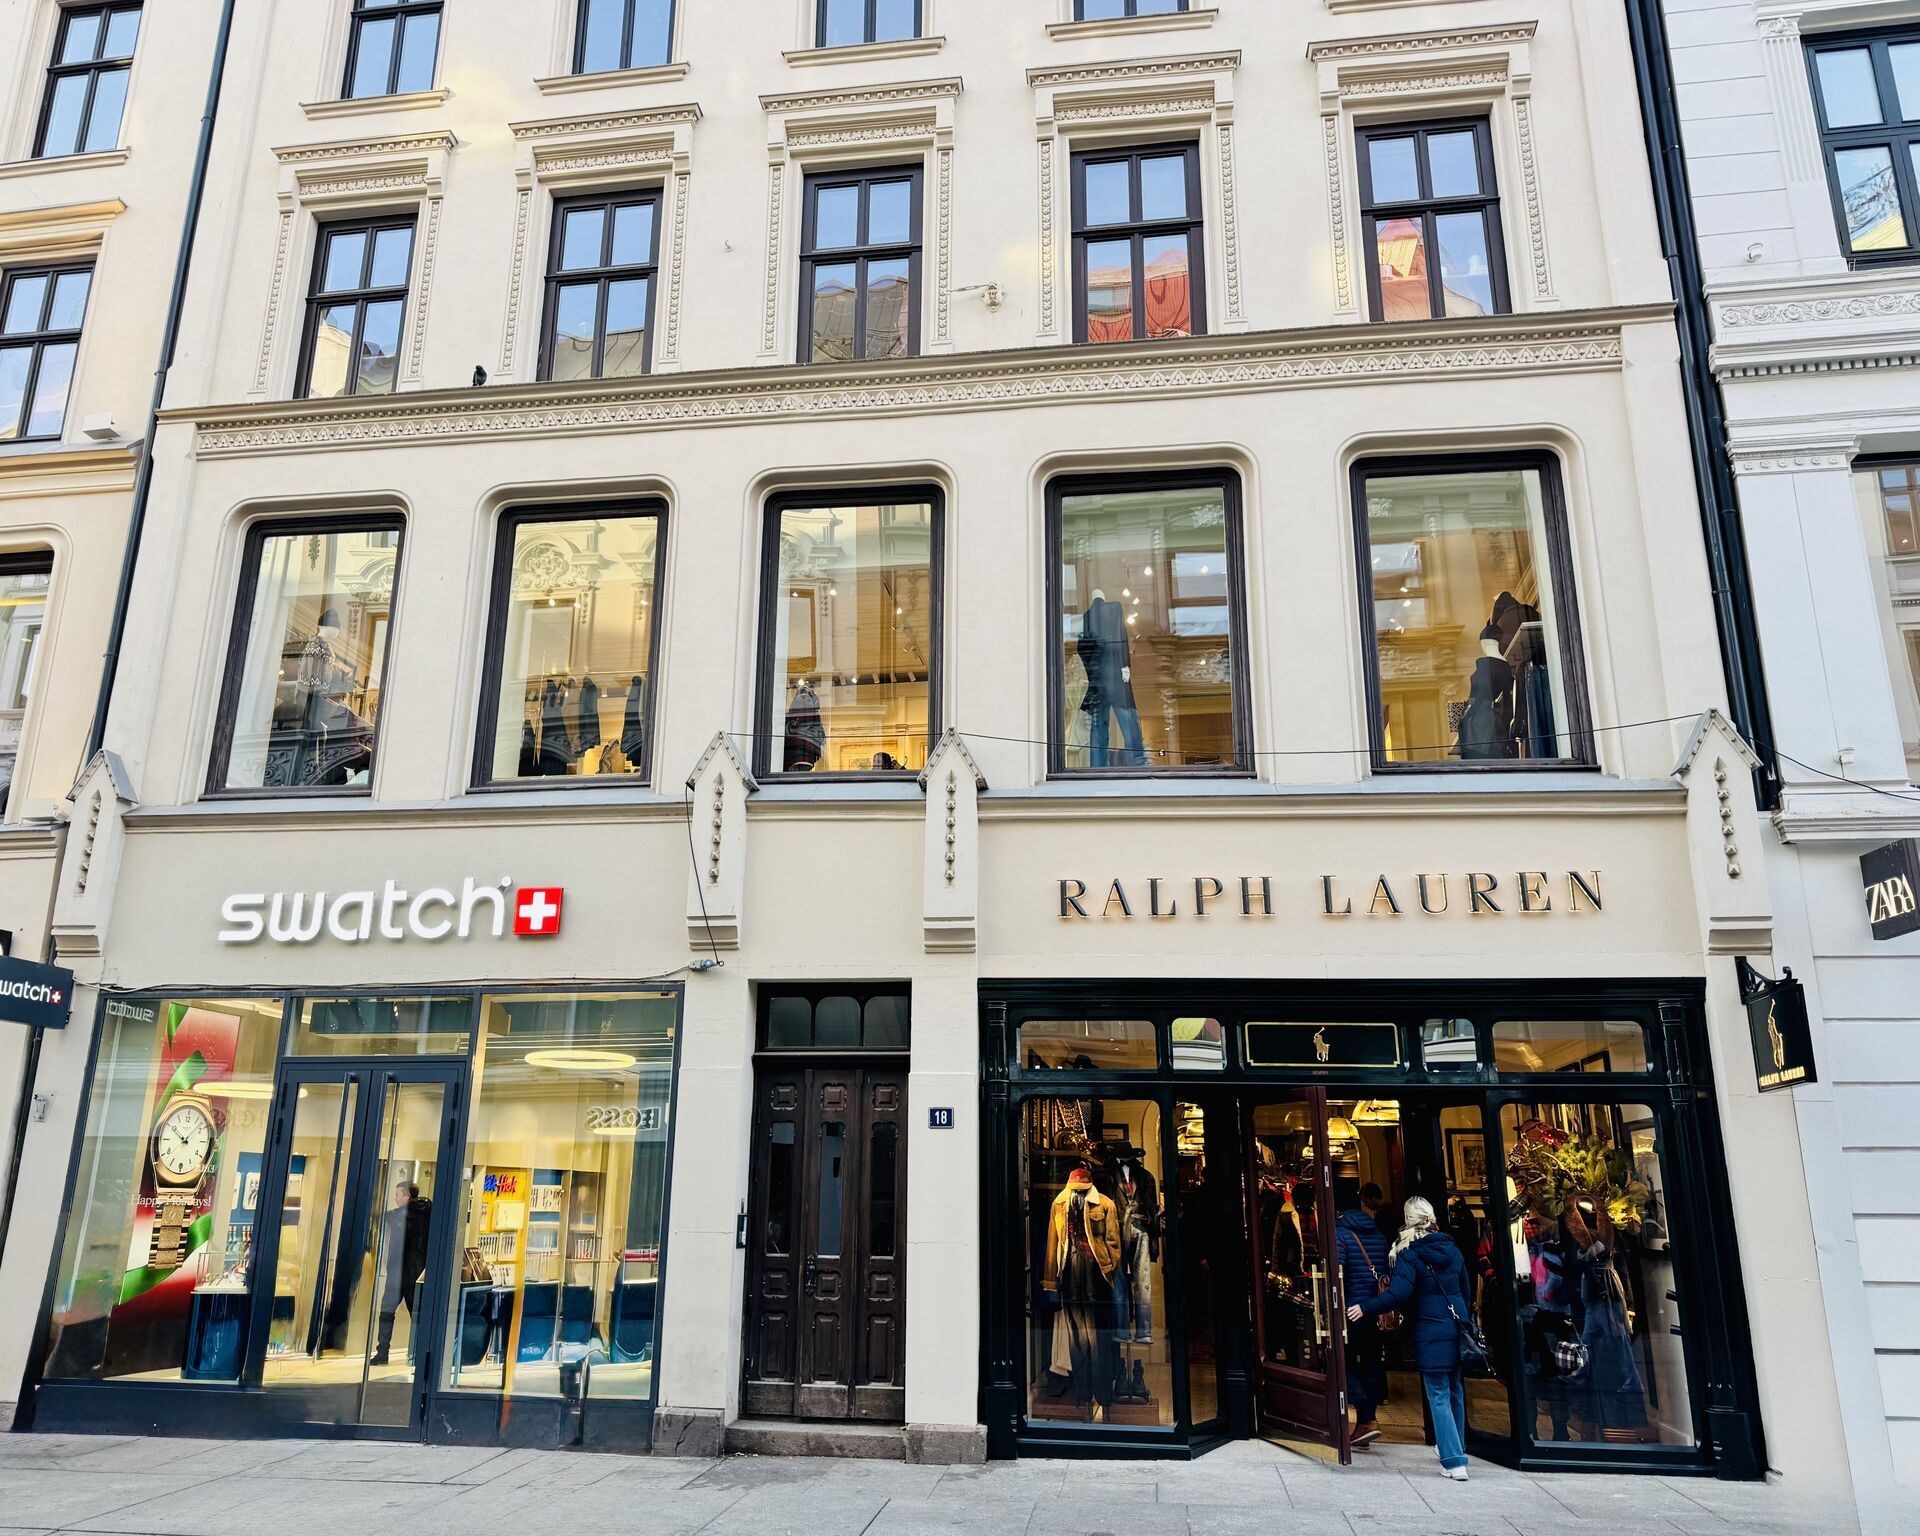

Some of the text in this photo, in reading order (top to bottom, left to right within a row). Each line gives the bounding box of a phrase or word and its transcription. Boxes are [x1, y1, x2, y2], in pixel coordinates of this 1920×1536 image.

[218, 876, 511, 942] swatch
[1057, 870, 1603, 918] RALPH LAUREN
[1865, 873, 1915, 923] ZARA
[0, 979, 52, 1003] watch
[935, 1110, 948, 1125] 18
[166, 1194, 211, 1209] Hoays!
